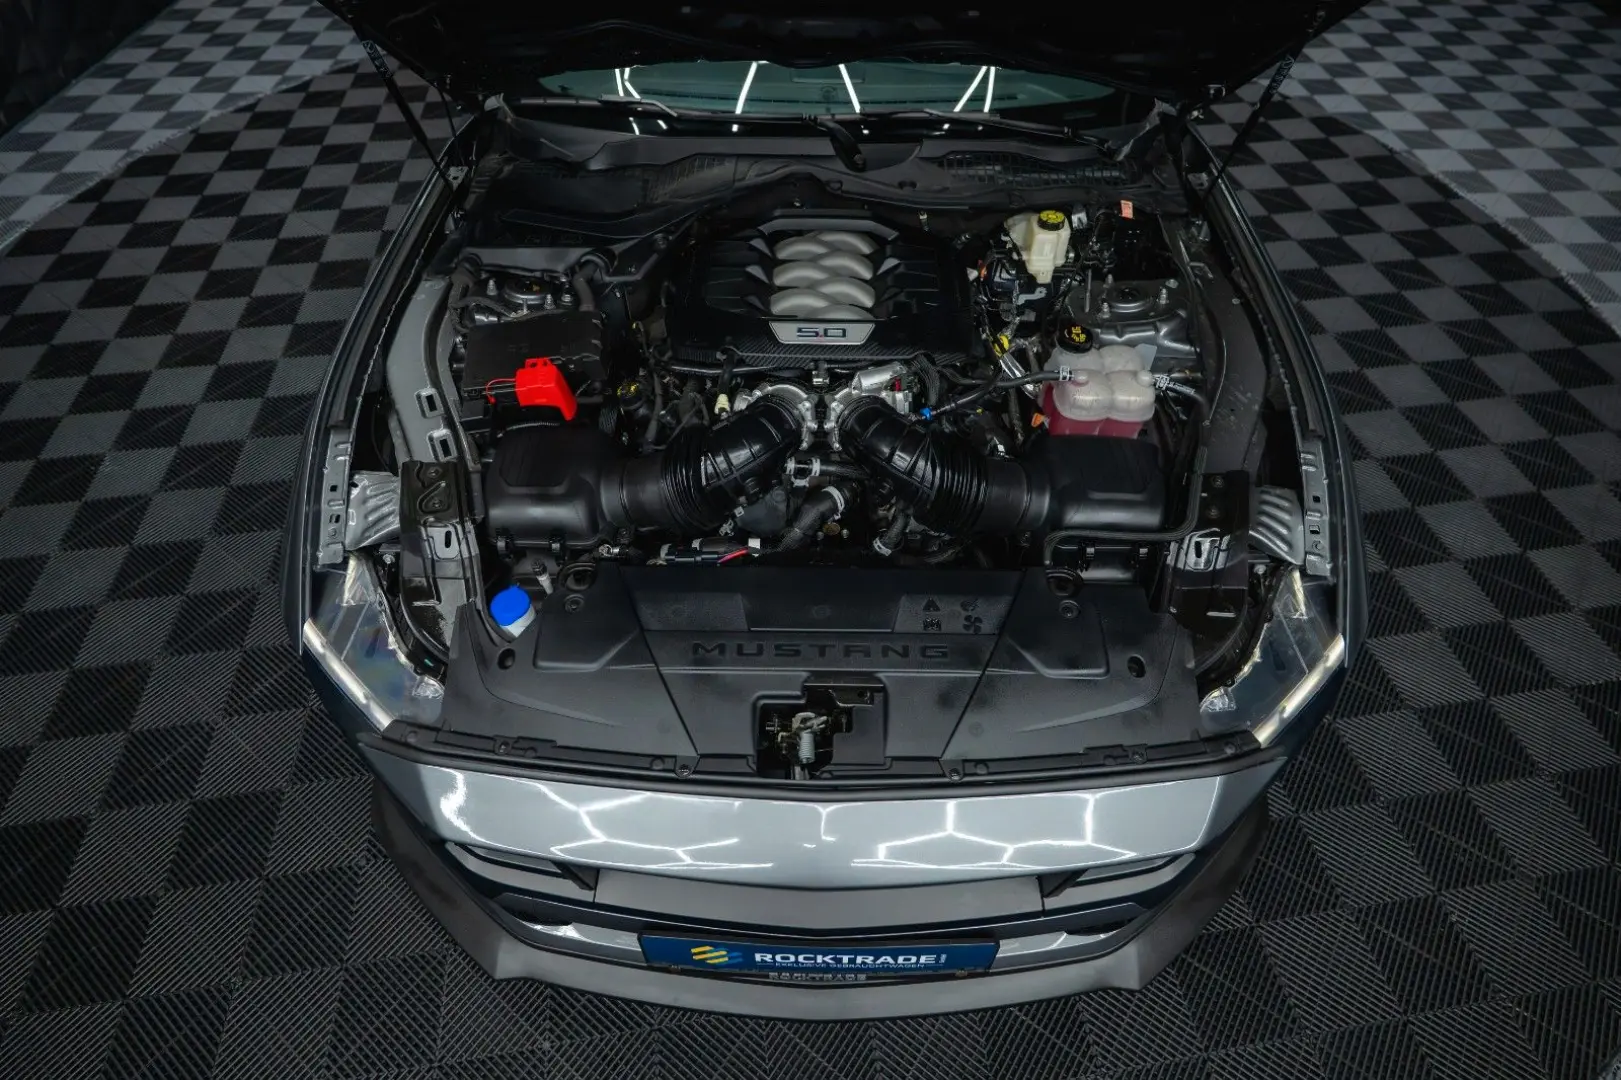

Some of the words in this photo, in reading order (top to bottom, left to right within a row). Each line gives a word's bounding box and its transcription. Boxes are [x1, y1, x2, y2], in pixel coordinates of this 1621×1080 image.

[796, 327, 847, 338] 5.0
[692, 642, 948, 659] MUSTANG
[754, 952, 937, 964] ROCKTRADE
